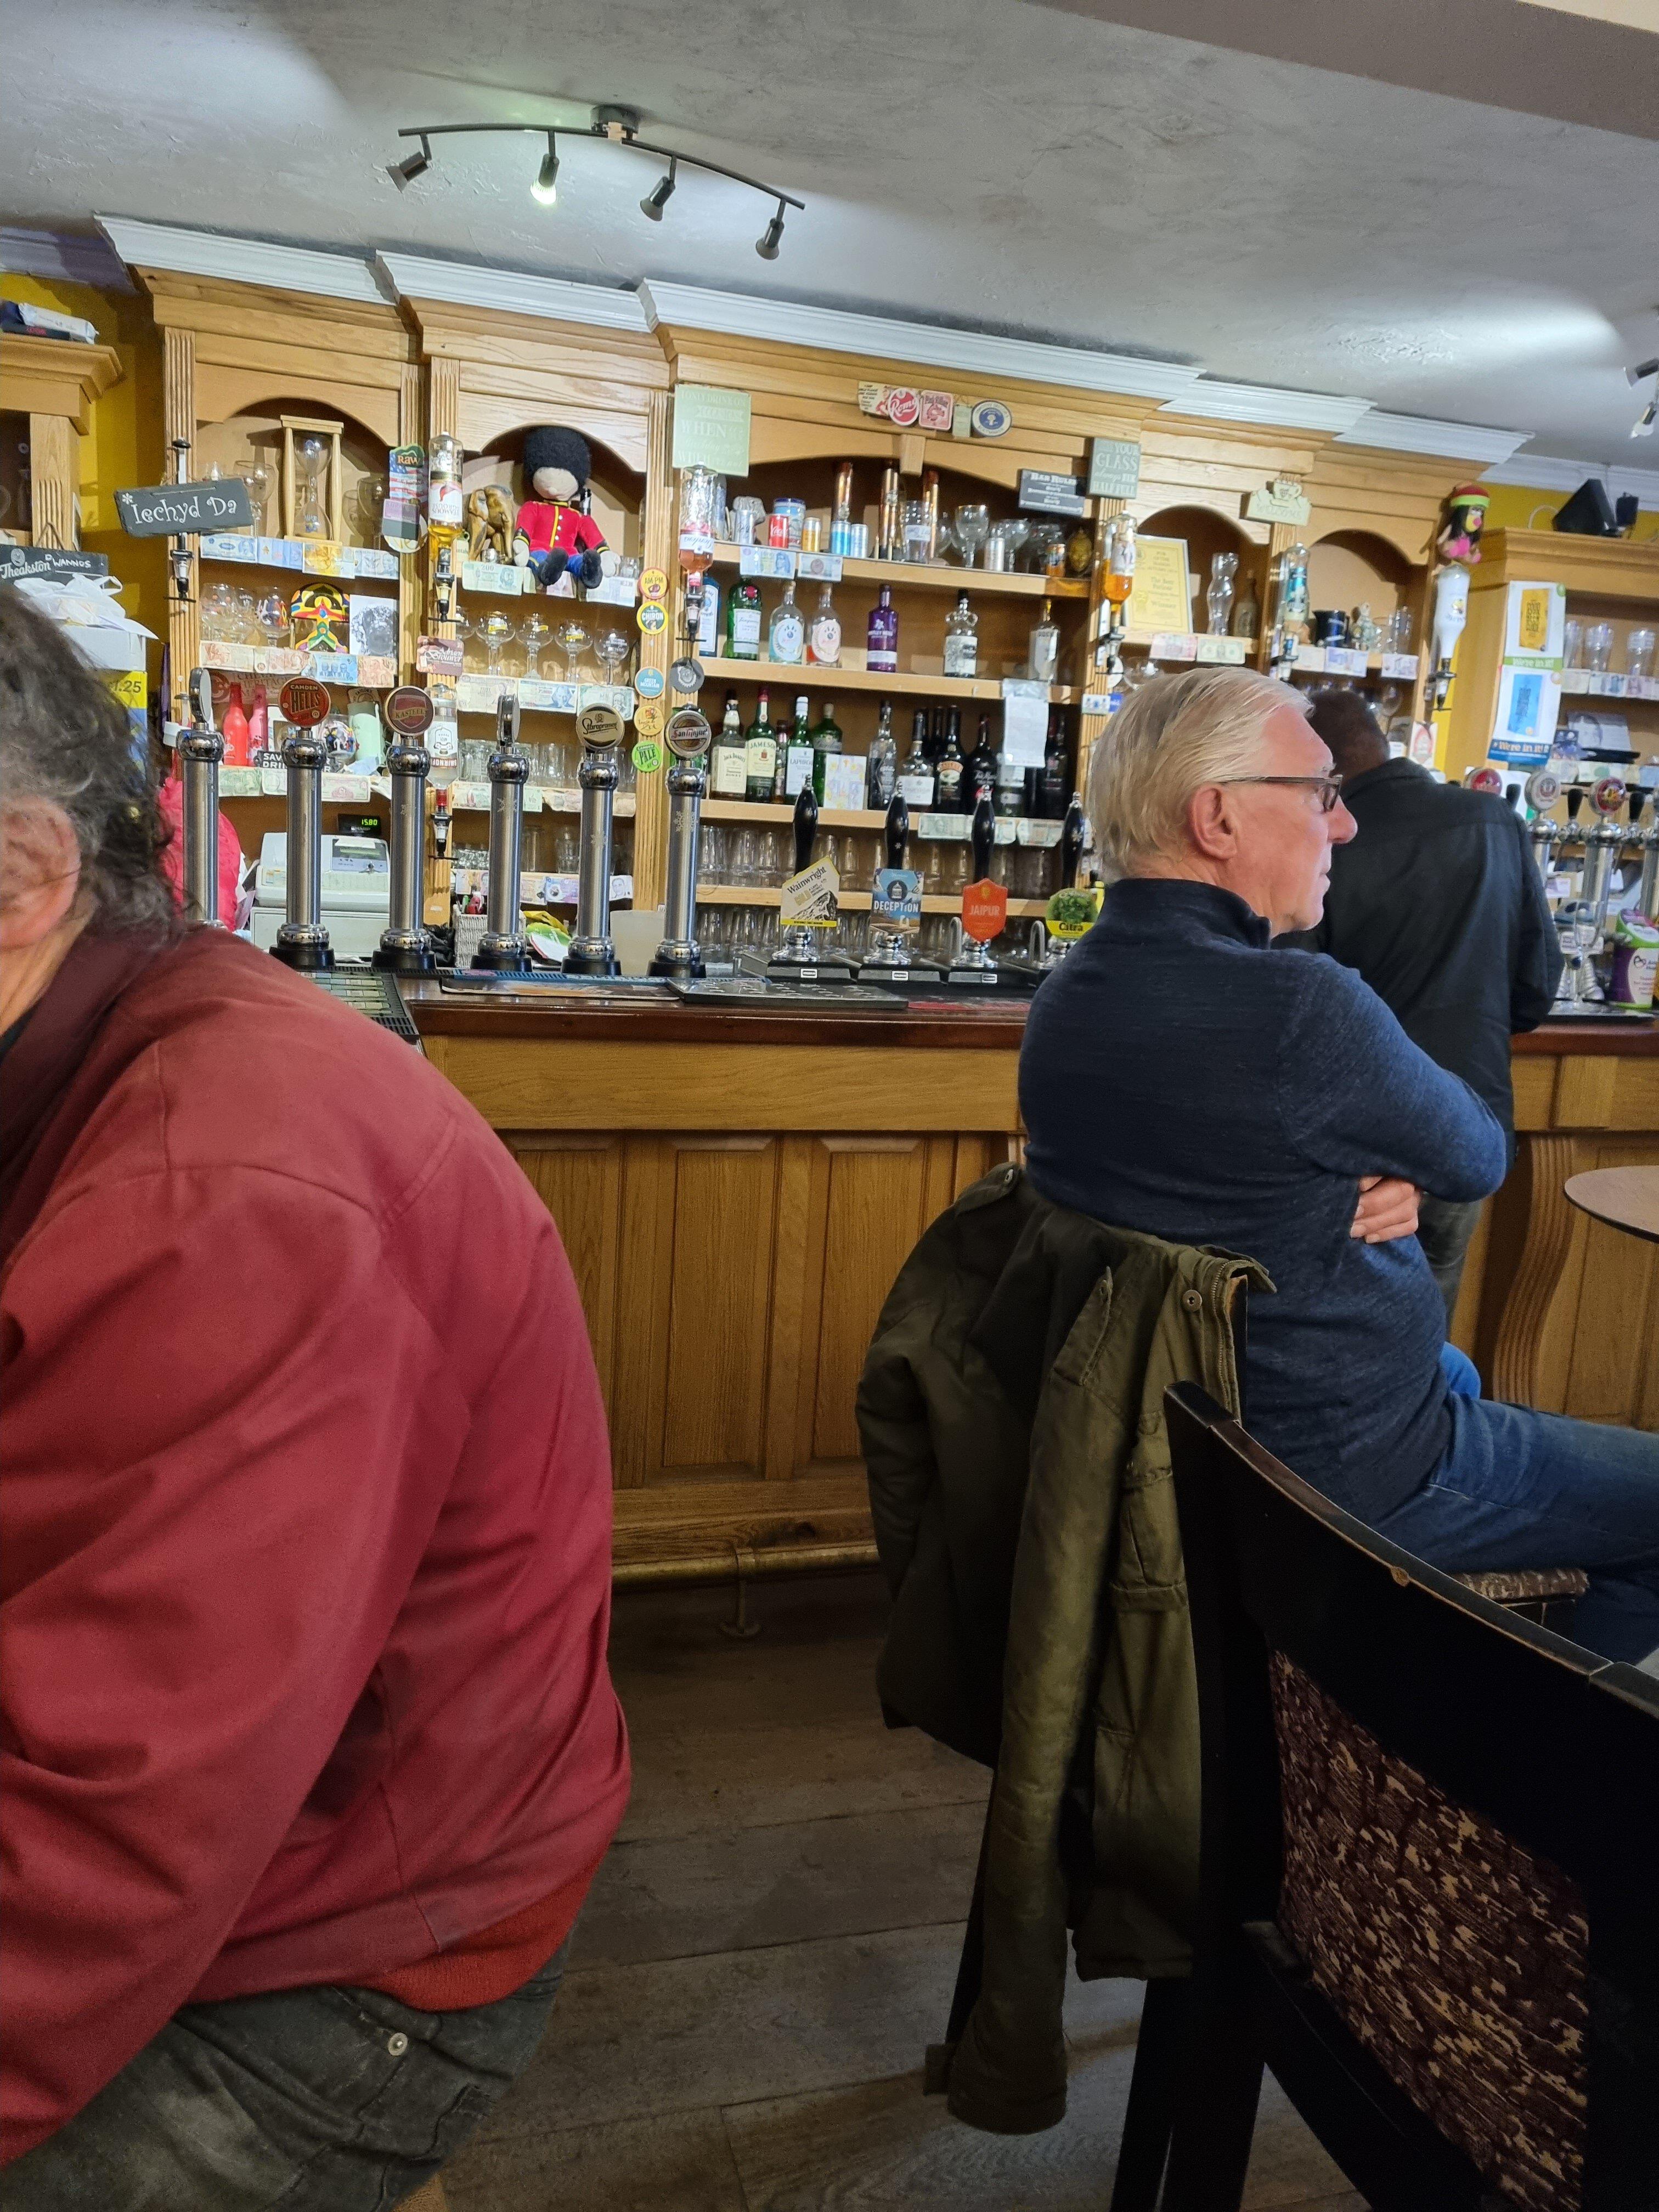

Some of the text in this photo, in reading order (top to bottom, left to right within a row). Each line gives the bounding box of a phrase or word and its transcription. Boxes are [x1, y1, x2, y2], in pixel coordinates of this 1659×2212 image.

[680, 419, 727, 438] WHEN
[1095, 453, 1138, 472] GLASS
[206, 496, 238, 517] Da
[0, 560, 52, 580] Theakston
[641, 611, 664, 621] CHIRON
[290, 689, 321, 714] HELLS
[582, 718, 618, 735] Staropramen
[671, 729, 686, 739] San
[263, 752, 283, 760] SAV
[639, 748, 657, 765] PALE
[787, 866, 827, 895] Wainwright
[873, 901, 919, 913] DECEPTION
[969, 905, 1000, 917] JAIPUR
[1058, 922, 1084, 932] Citra
